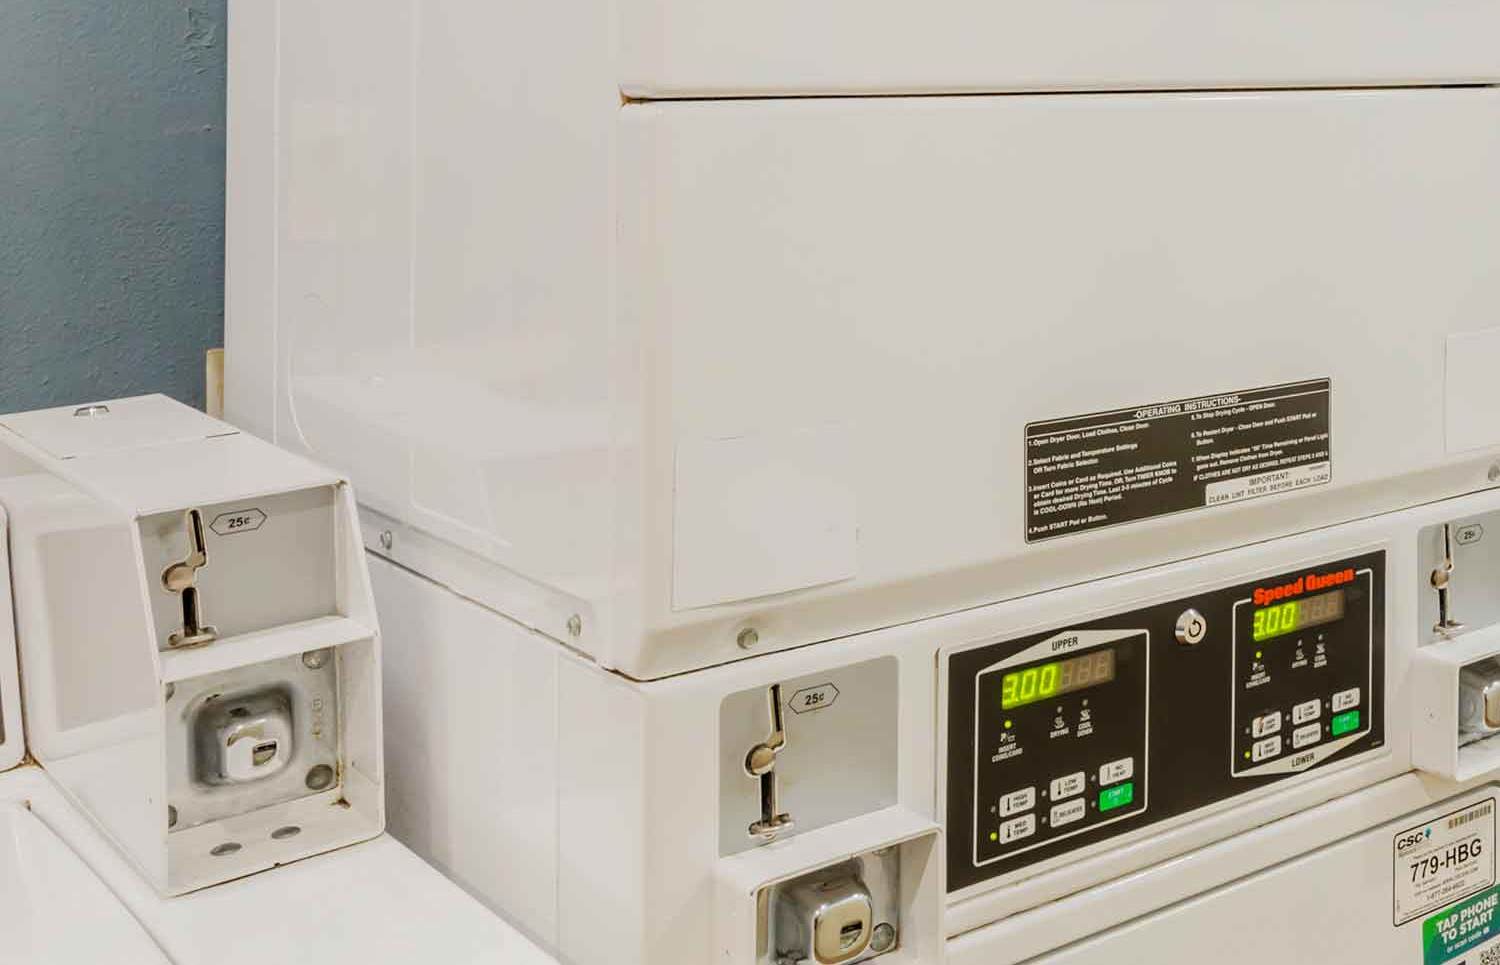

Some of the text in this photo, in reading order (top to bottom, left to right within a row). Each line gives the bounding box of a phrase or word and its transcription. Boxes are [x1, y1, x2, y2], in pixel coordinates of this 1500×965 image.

[228, 516, 251, 528] 25¢
[1254, 568, 1355, 605] Speed Queen
[1051, 636, 1079, 651] UPPER
[805, 692, 824, 706] 25¢
[1291, 752, 1315, 767] LOWER
[1064, 784, 1079, 793] TEMP
[1013, 799, 1028, 808] TEMP
[1013, 826, 1029, 835] TEMP
[1397, 832, 1423, 849] CSC
[1410, 838, 1482, 882] 779-HBG
[1436, 914, 1458, 933] TAP
[1460, 893, 1499, 919] PHONE
[1441, 909, 1494, 944] TO START
